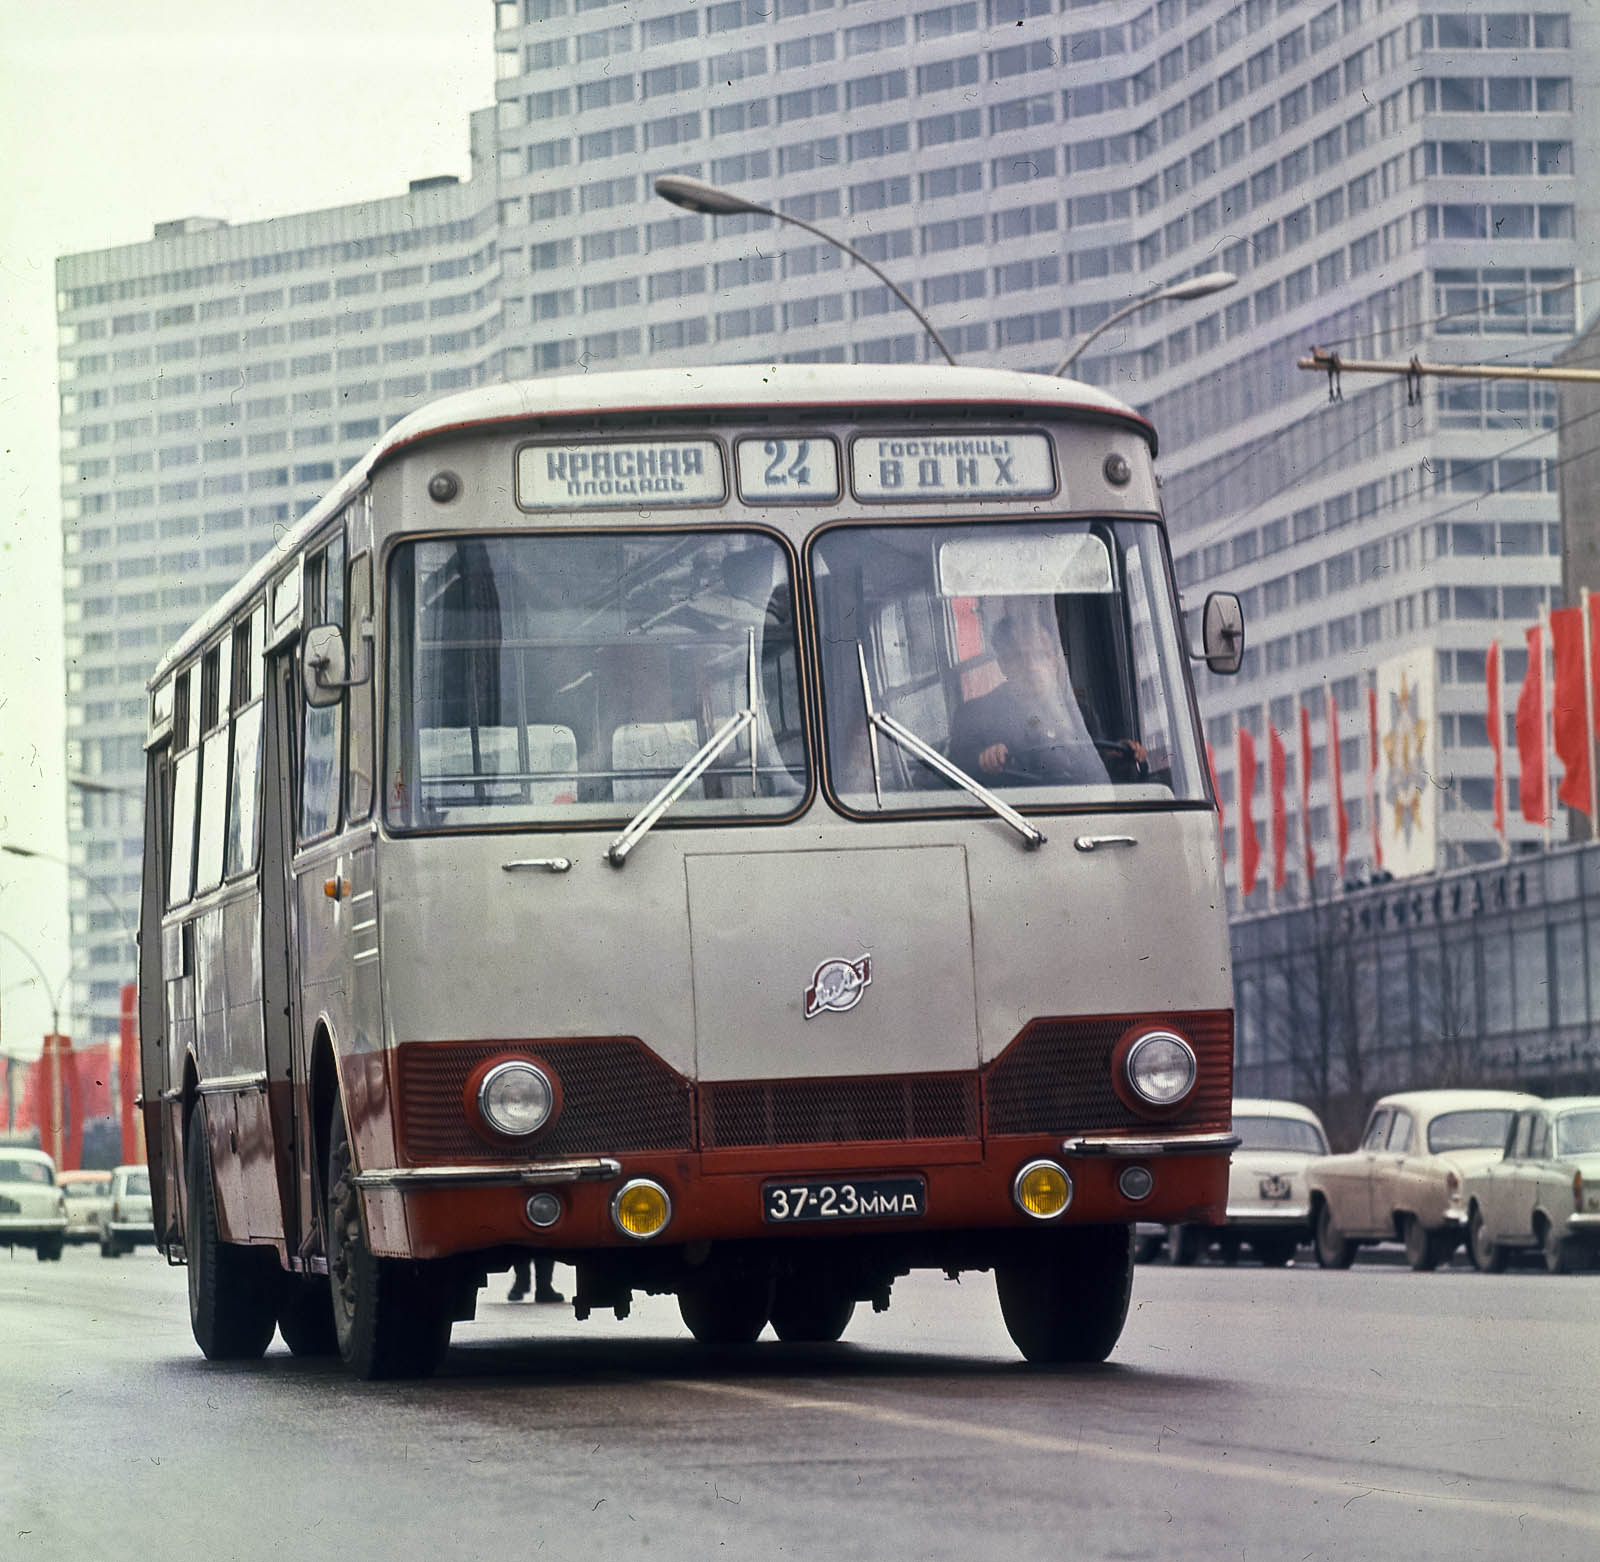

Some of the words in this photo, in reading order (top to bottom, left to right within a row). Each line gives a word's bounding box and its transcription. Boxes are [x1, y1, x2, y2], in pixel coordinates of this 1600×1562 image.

[878, 439, 1011, 458] ГОСТИНИЦЫ
[547, 448, 704, 481] КРАСНАЯ
[764, 439, 811, 486] 24
[567, 477, 685, 496] ПЛОЩАДЬ
